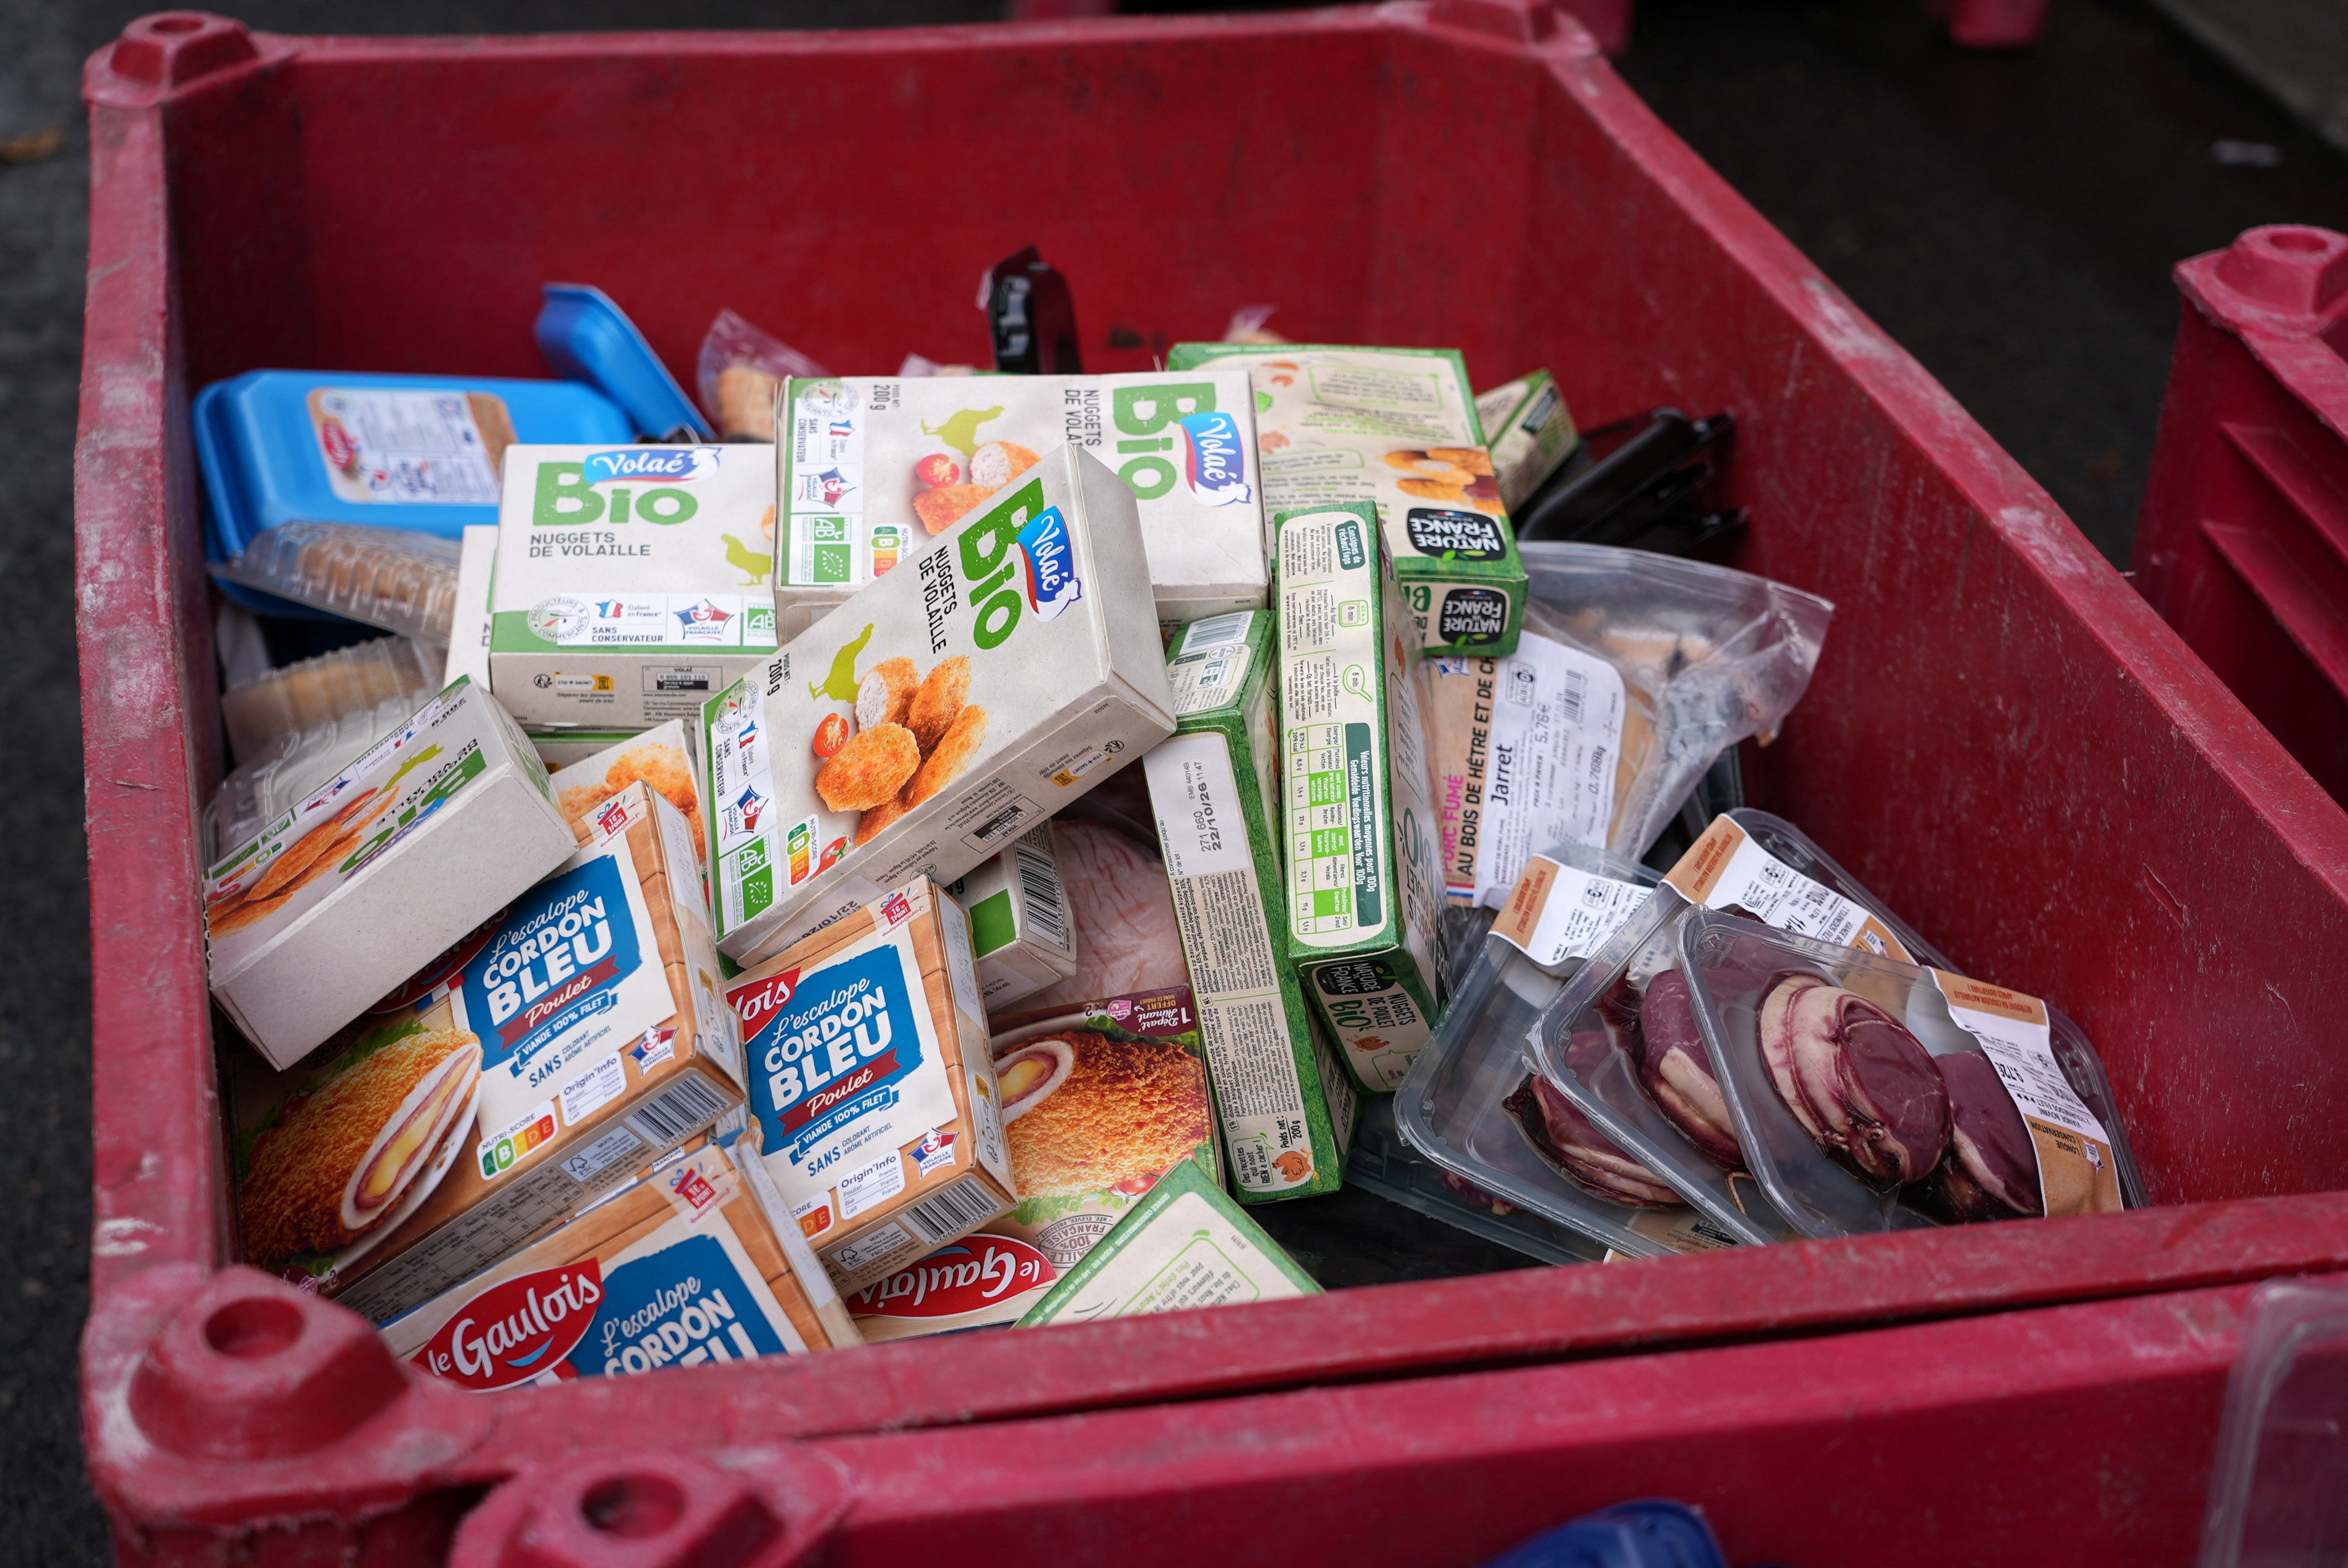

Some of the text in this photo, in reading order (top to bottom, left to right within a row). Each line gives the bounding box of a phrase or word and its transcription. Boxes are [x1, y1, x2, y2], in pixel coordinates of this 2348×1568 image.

[873, 385, 890, 403] 200
[1065, 390, 1081, 404] DE
[809, 419, 818, 434] SANS
[1084, 390, 1101, 446] NUGGETS
[797, 419, 806, 463] CONSERVATEUR
[1113, 383, 1216, 500] Bio
[1197, 417, 1237, 481] Volaé
[593, 452, 684, 475] Volaé
[533, 462, 698, 525] Bio
[531, 532, 615, 545] NUGGETS
[1347, 525, 1359, 554] Consignes
[1410, 517, 1493, 535] FRANCE
[1415, 533, 1501, 551] NATURE
[529, 544, 651, 558] DE VOLAILLE
[958, 477, 1044, 649] Bio
[1031, 515, 1068, 591] Volaé
[1338, 528, 1351, 565] réchauffage
[934, 545, 957, 615] NUGGETS
[919, 556, 946, 654] DE VOLAILLE
[1444, 599, 1502, 614] FRANCE
[1442, 618, 1502, 635] NATURE
[767, 659, 782, 696] 200 g
[1477, 677, 1492, 698] DE
[1476, 702, 1490, 723] ET
[715, 744, 725, 798] CONSERVATEUR
[1466, 726, 1489, 783] HÊTRE
[1183, 762, 1192, 783] 44014B
[1491, 744, 1512, 806] Jarret
[1194, 761, 1221, 850] 22/10/26 11:47
[1443, 773, 1464, 822] FUMÉ
[1467, 786, 1481, 806] DE
[1193, 811, 1211, 852] 271 660
[1350, 759, 1365, 885] Gemiddelde Voedingswaarden Voor 100g
[1360, 750, 1376, 892] Valeurs nutritionnelles moyennes pour 100g
[1461, 808, 1479, 849] BOIS
[740, 849, 758, 872] AB
[1158, 819, 1175, 871] consommer jusqu'au
[1458, 847, 1474, 876] AU
[1176, 889, 1185, 905] kippen
[483, 896, 606, 989] CORDON
[490, 888, 589, 965] L'escalope
[487, 919, 613, 1026] BLEU
[1330, 966, 1359, 994] FRANCE
[1353, 962, 1381, 992] NATURE
[525, 974, 592, 1028] Poulet
[771, 978, 872, 1045] L'escalope
[1137, 1007, 1178, 1020] Aimant
[1147, 1000, 1177, 1010] OFFERT
[1181, 1007, 1192, 1024] 1
[1367, 997, 1396, 1028] DE POULET
[1387, 993, 1417, 1025] NUGGETS
[522, 1011, 579, 1055] VIANDE 100%
[562, 1030, 590, 1055] COLORANT
[564, 1026, 612, 1064] ARÔME ARTIFICIEL
[764, 986, 887, 1073] CORDON
[529, 1054, 562, 1085] SANS
[768, 1010, 893, 1112] BLEU
[807, 1067, 873, 1117] Poulet
[481, 1112, 537, 1151] NUTRI-SCORE
[803, 1104, 860, 1144] VIANDE 100%
[842, 1125, 871, 1147] COLORANT
[843, 1122, 893, 1157] ARÔME ARTIFICIEL
[1229, 1121, 1237, 1129] FR
[1279, 1132, 1289, 1148] Poids
[1290, 1125, 1301, 1138] 200
[2030, 1121, 2076, 1143] CONSERVATION
[807, 1147, 842, 1177] SANS
[921, 1153, 952, 1171] FRANÇAISE
[922, 1148, 950, 1166] VOLAILLE
[1237, 1147, 1250, 1183] Des recettes
[1255, 1144, 1270, 1183] RIEN cacher
[2057, 1141, 2081, 1156] LONGUE
[841, 1154, 898, 1189] Origin'Info
[843, 1164, 898, 1198] Poulet France
[1249, 1167, 1258, 1176] qui
[844, 1174, 899, 1207] Blé France
[846, 1183, 901, 1216] Lait France
[936, 1224, 969, 1244] 266980
[1043, 1220, 1107, 1247] FRANÇAISE
[1058, 1234, 1092, 1250] 100%
[1021, 1258, 1042, 1281] le
[427, 1273, 602, 1378] le Gaulois
[599, 1276, 702, 1358] L'escalope
